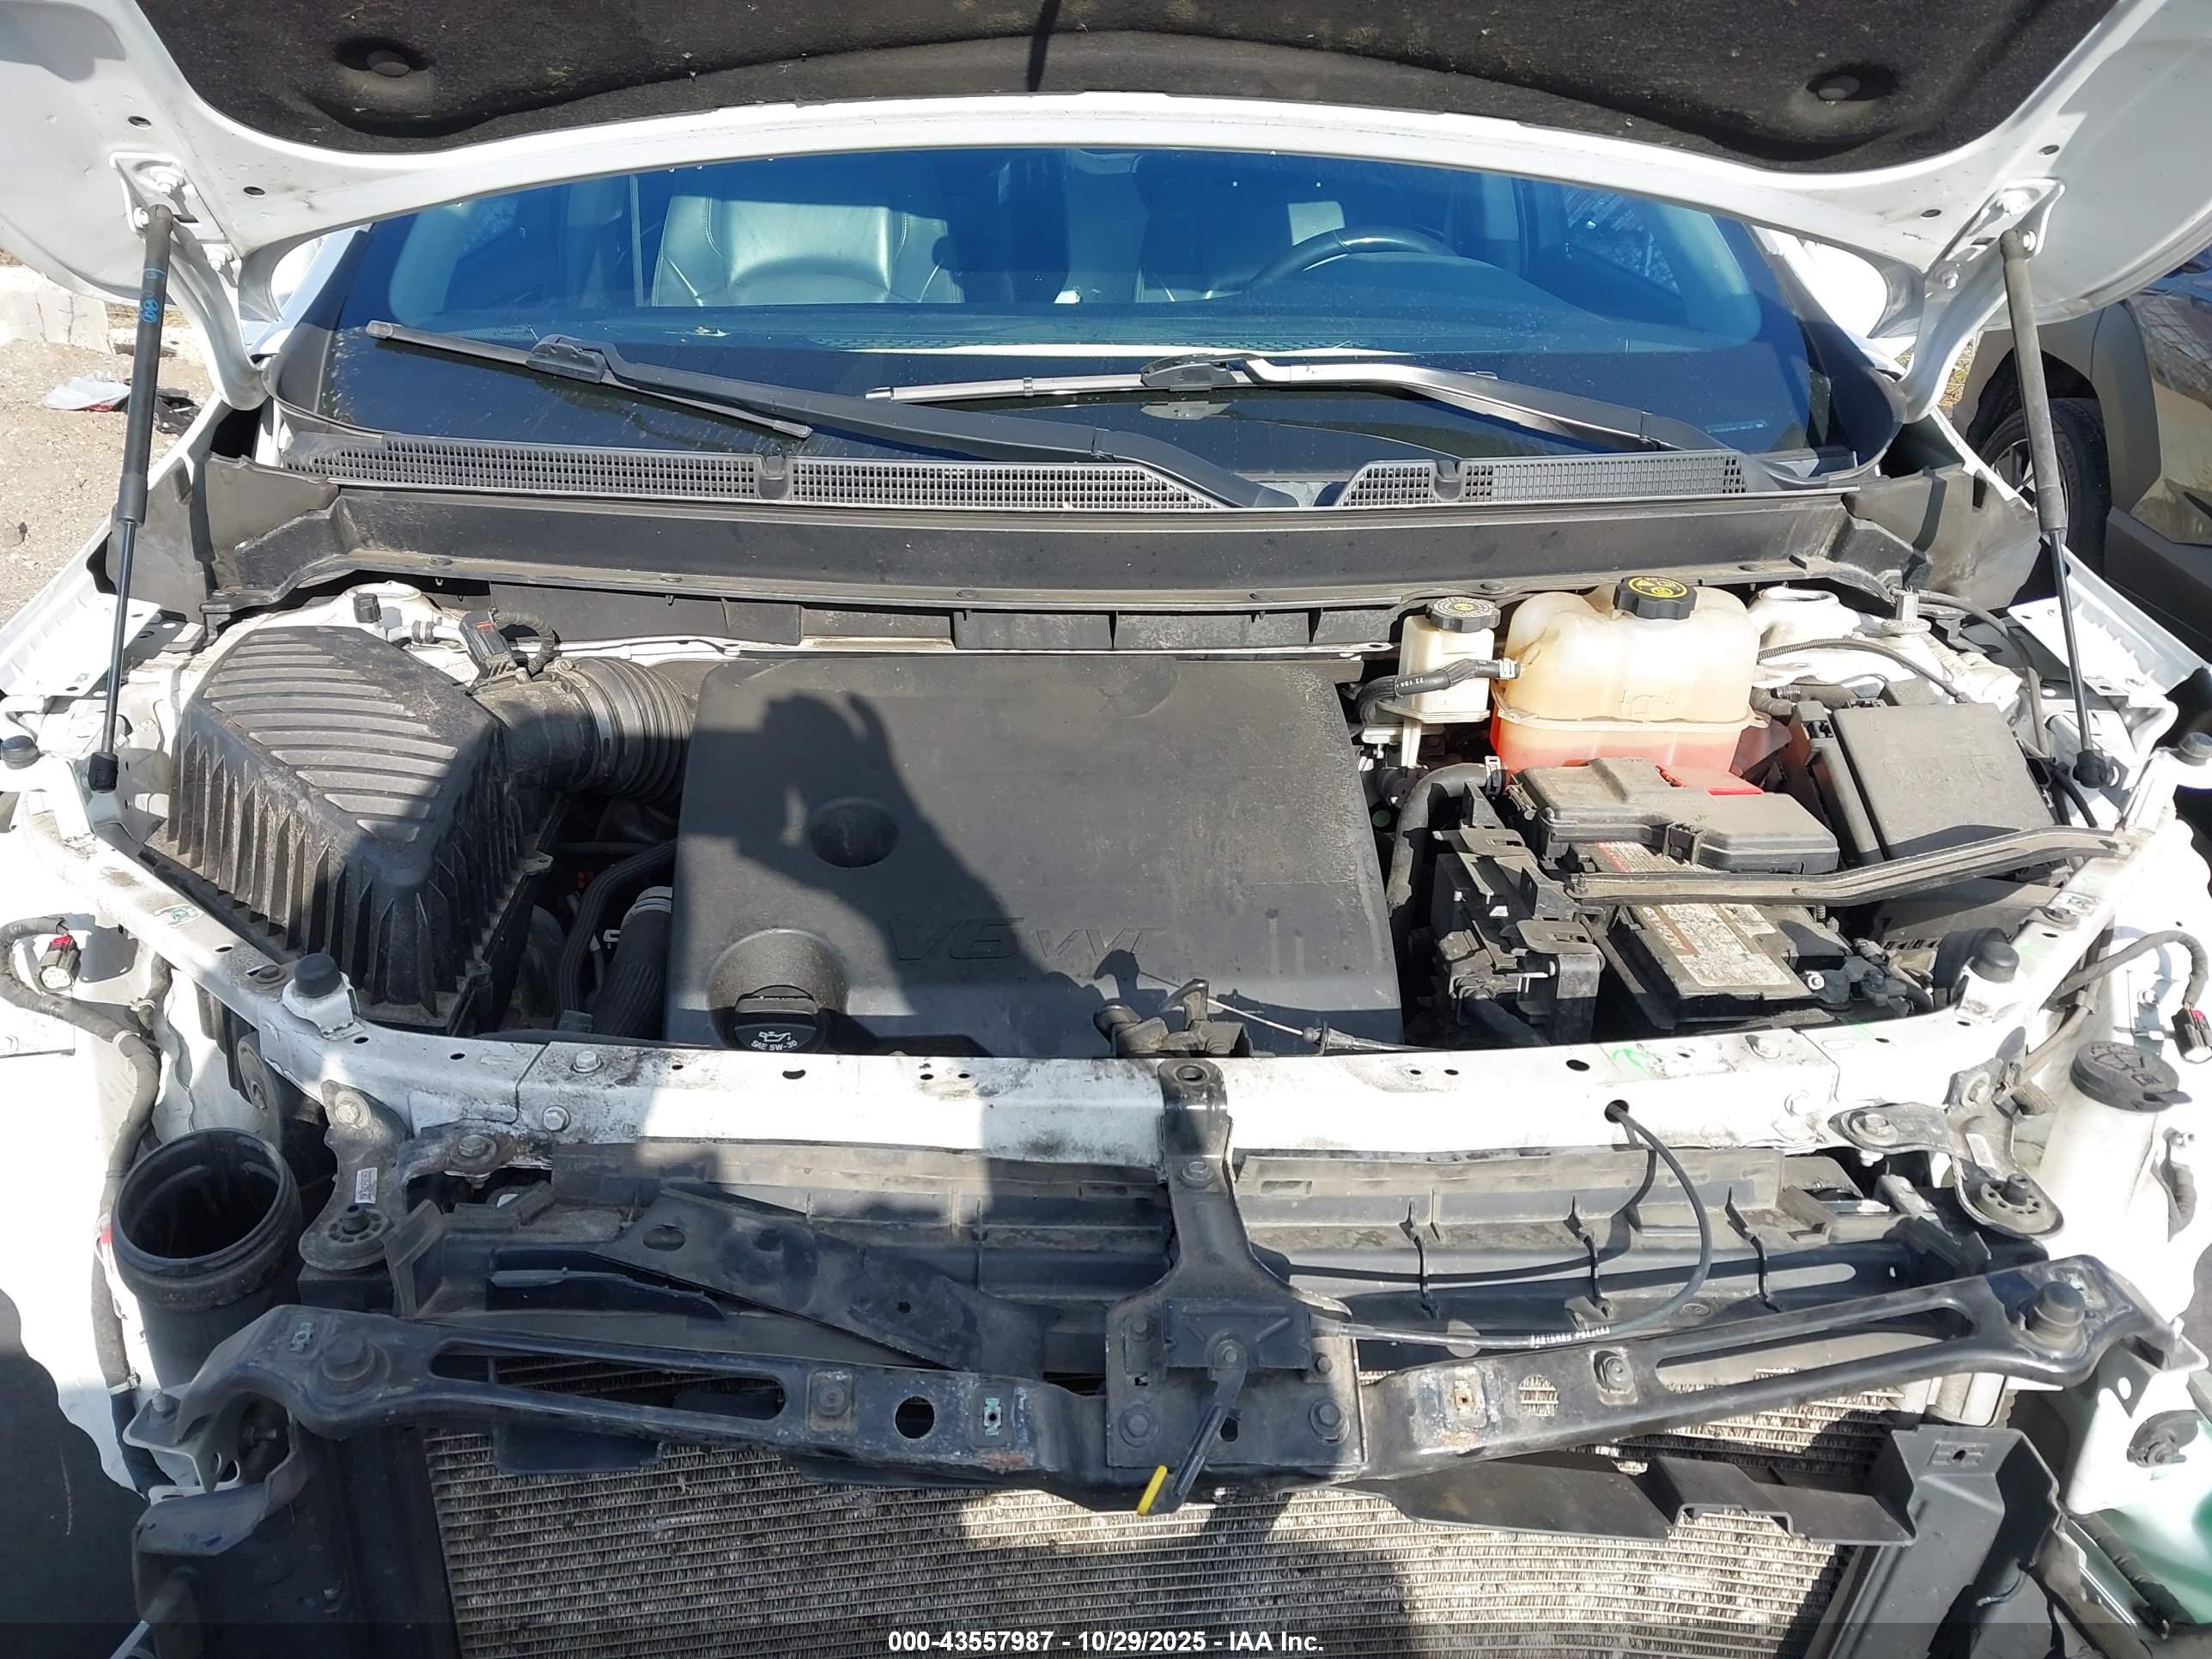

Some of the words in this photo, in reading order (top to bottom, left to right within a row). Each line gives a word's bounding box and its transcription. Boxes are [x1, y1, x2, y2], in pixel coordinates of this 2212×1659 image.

[886, 917, 1024, 961] V6
[1034, 927, 1169, 957] VVT
[750, 1039, 769, 1051] SAE
[769, 1040, 799, 1051] 5W-30
